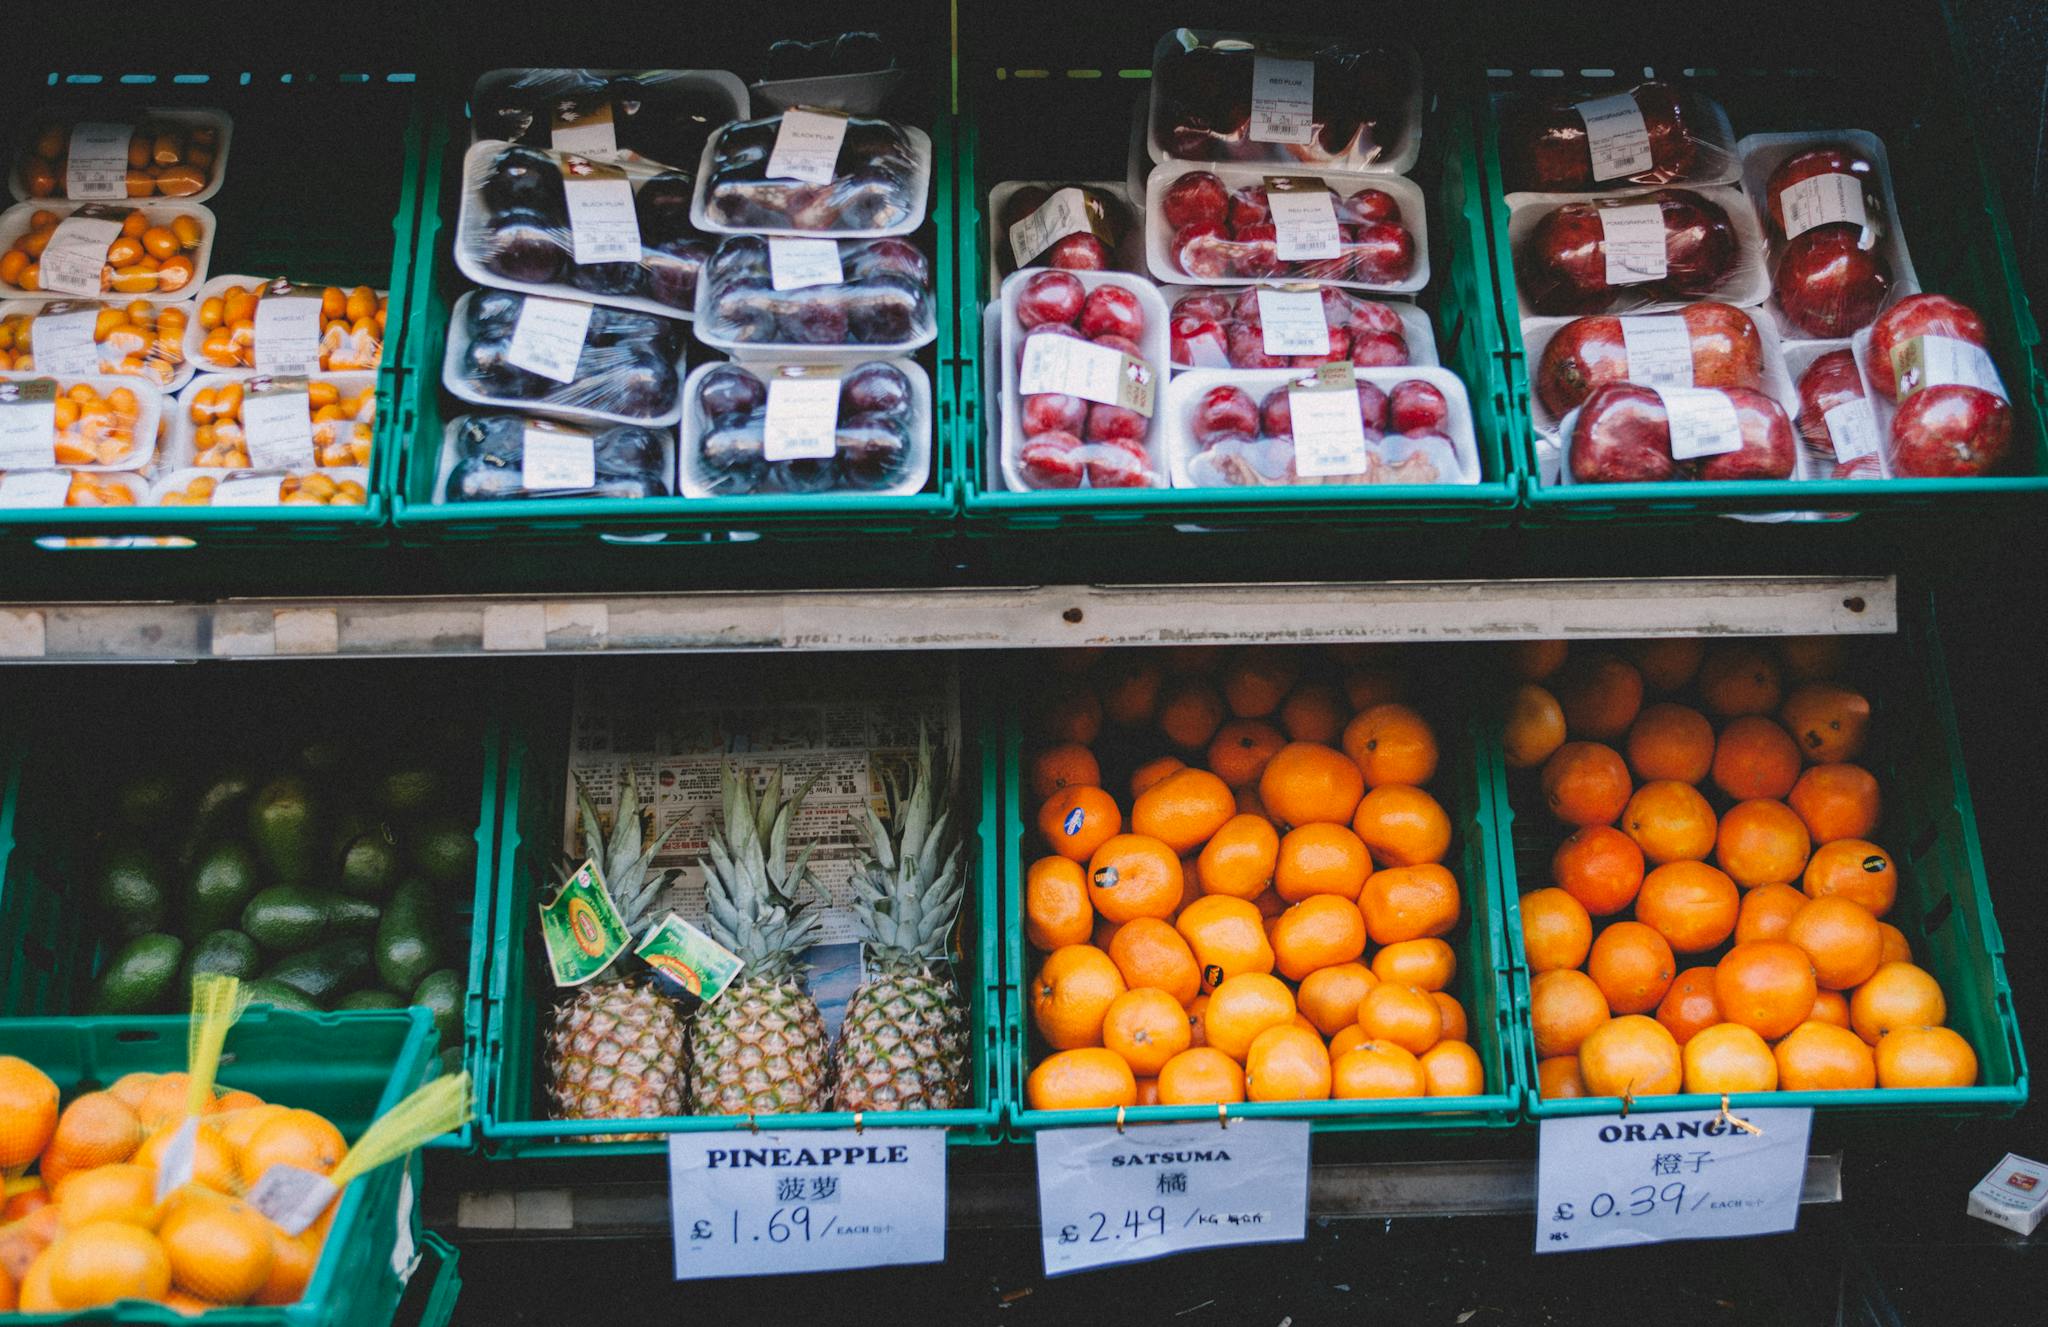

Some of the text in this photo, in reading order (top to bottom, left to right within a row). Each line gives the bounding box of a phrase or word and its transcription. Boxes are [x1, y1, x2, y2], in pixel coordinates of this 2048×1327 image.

[1284, 79, 1302, 87] PLUM
[1586, 110, 1631, 122] POMEGRANATE
[1605, 218, 1654, 226] POMEGRANATE
[1627, 327, 1678, 336] POMEGRANATE
[1598, 1117, 1750, 1143] ORANGE
[706, 1145, 909, 1169] PINEAPPLE
[1112, 1150, 1232, 1167] SATSUMA
[1652, 1150, 1715, 1177] 橙子
[777, 1175, 839, 1202] 菠萝
[1156, 1172, 1187, 1195] 橘
